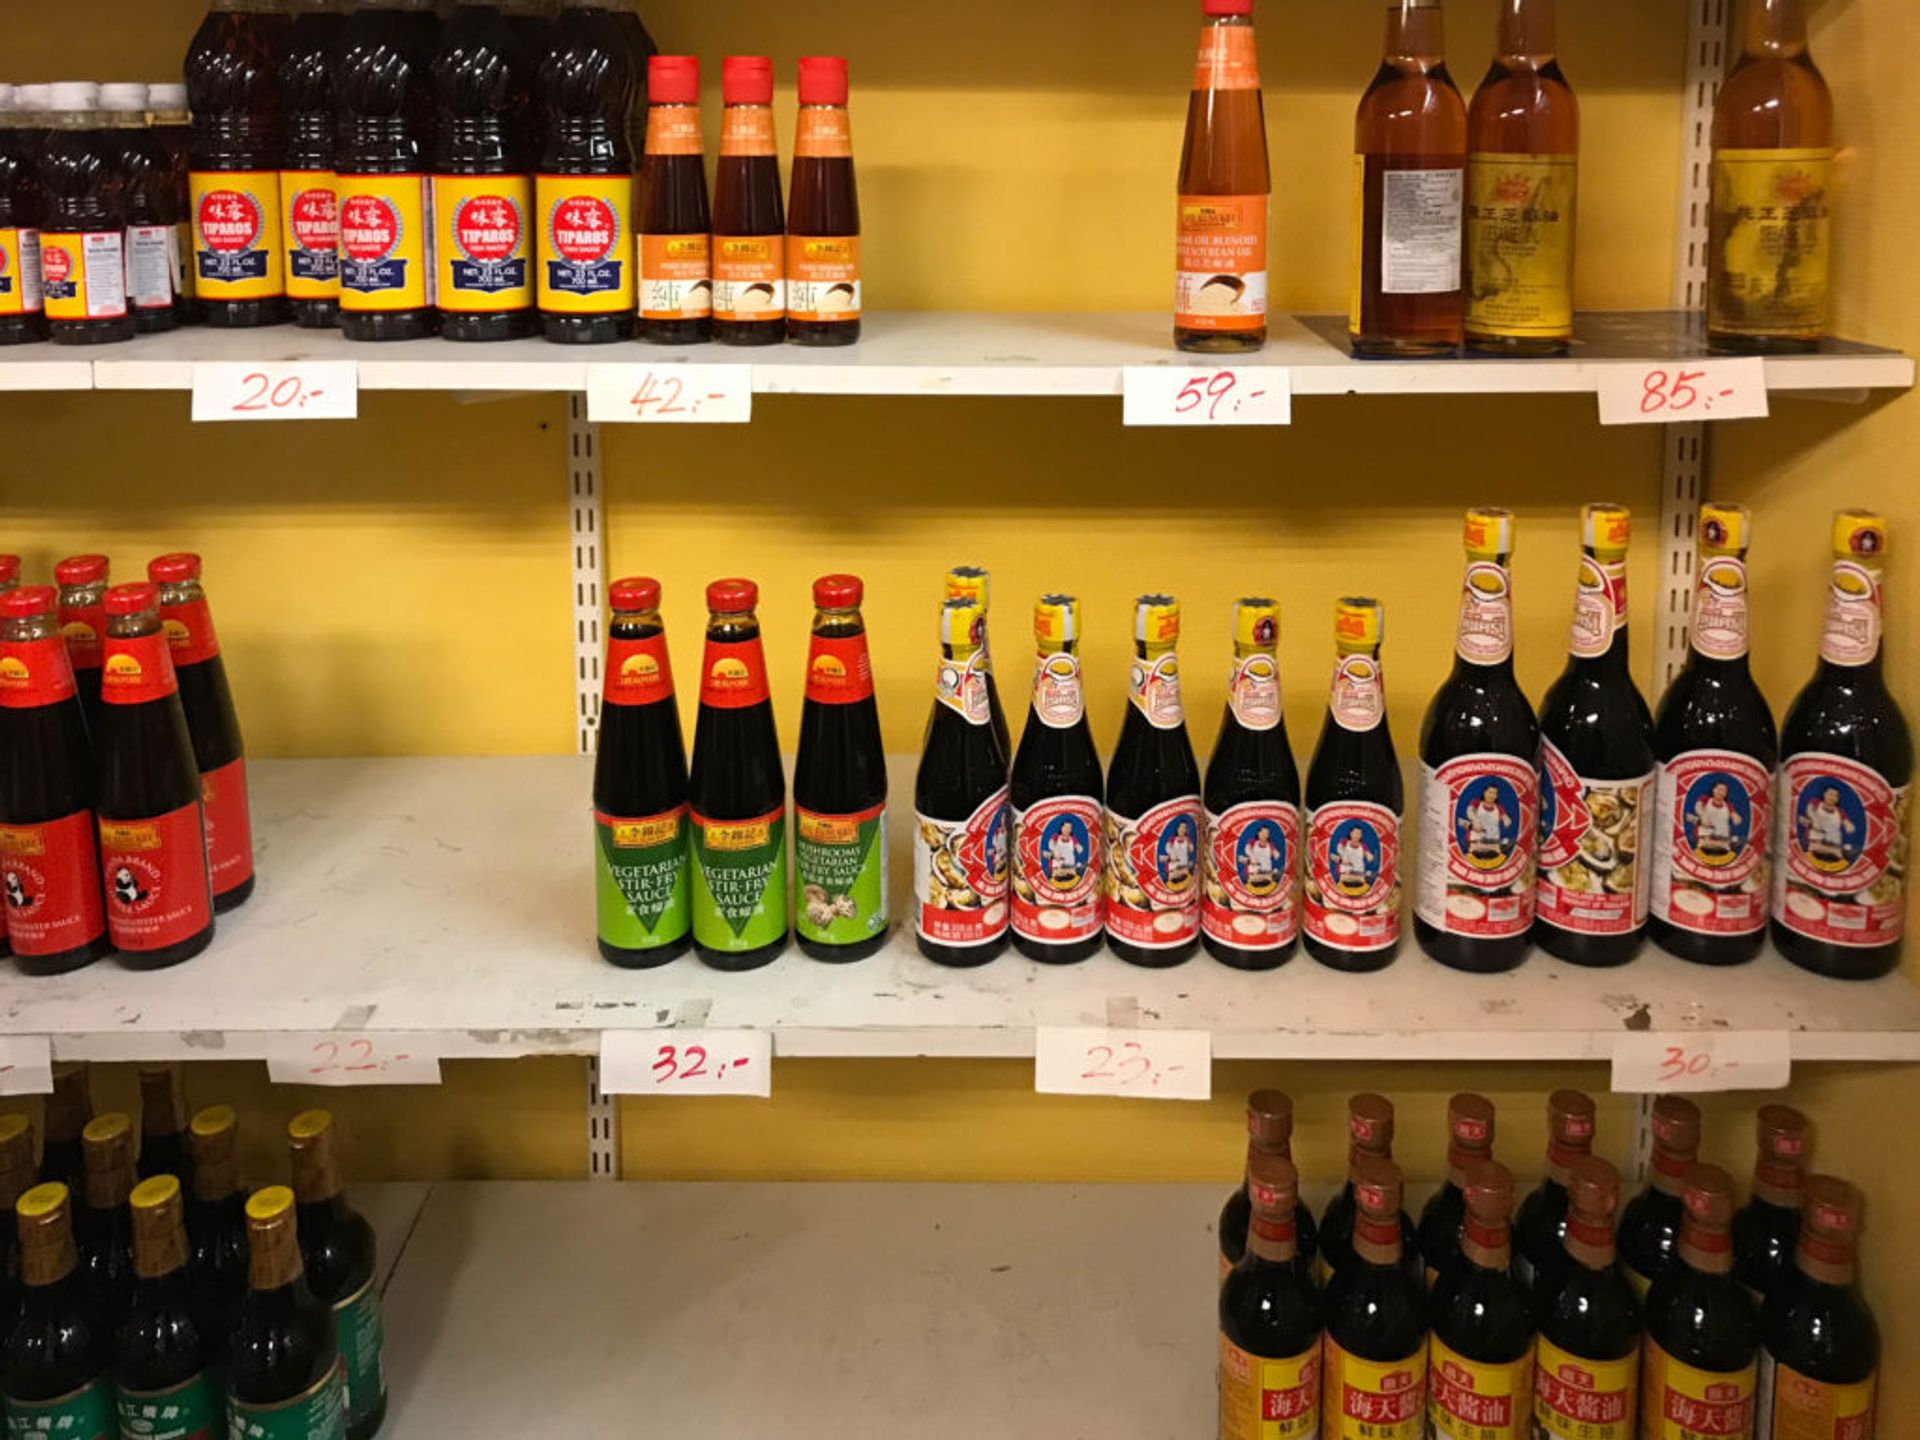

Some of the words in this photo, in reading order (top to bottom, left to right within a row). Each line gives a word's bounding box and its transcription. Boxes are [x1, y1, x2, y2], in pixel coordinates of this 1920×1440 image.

[203, 222, 252, 235] TIPAROS
[461, 229, 514, 243] TIPAROS
[557, 230, 609, 245] TIPAROS
[626, 884, 672, 903] SAUCE
[717, 890, 761, 906] SAUCE
